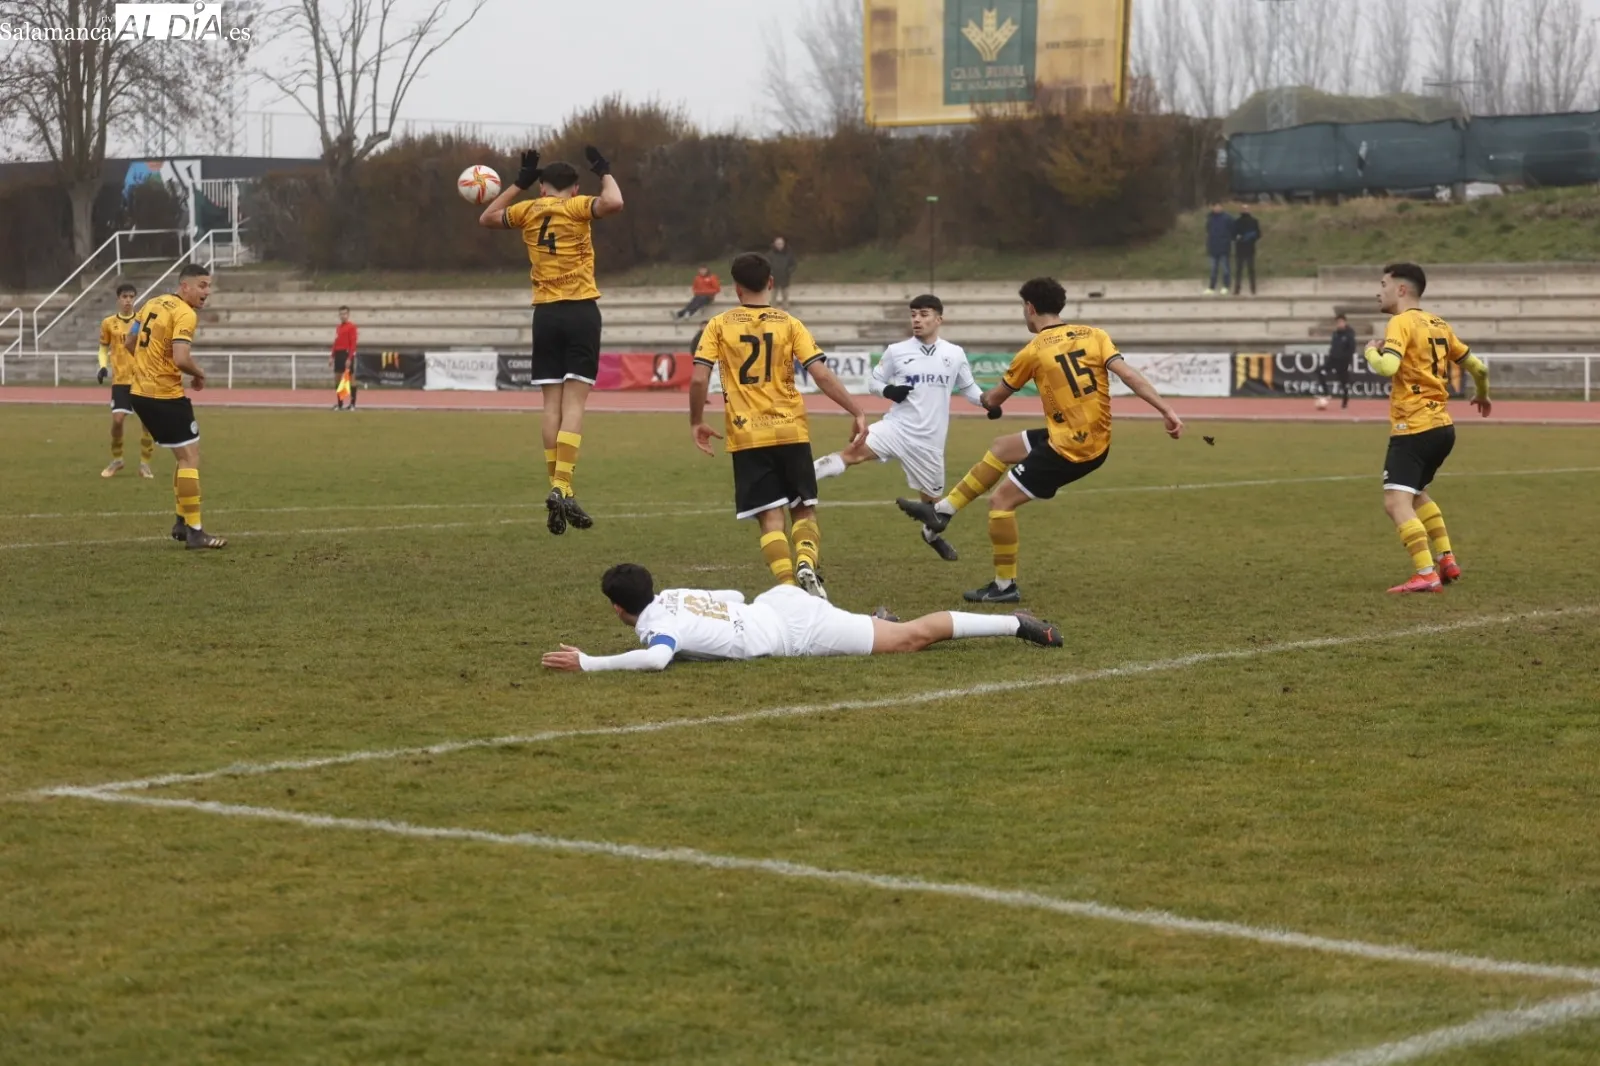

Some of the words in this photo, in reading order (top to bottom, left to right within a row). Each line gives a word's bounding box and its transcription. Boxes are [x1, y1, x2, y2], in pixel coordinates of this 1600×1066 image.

[537, 216, 557, 255] 4
[139, 312, 158, 348] 5
[739, 332, 773, 385] 21
[1055, 349, 1098, 399] 15
[1428, 337, 1450, 379] 17
